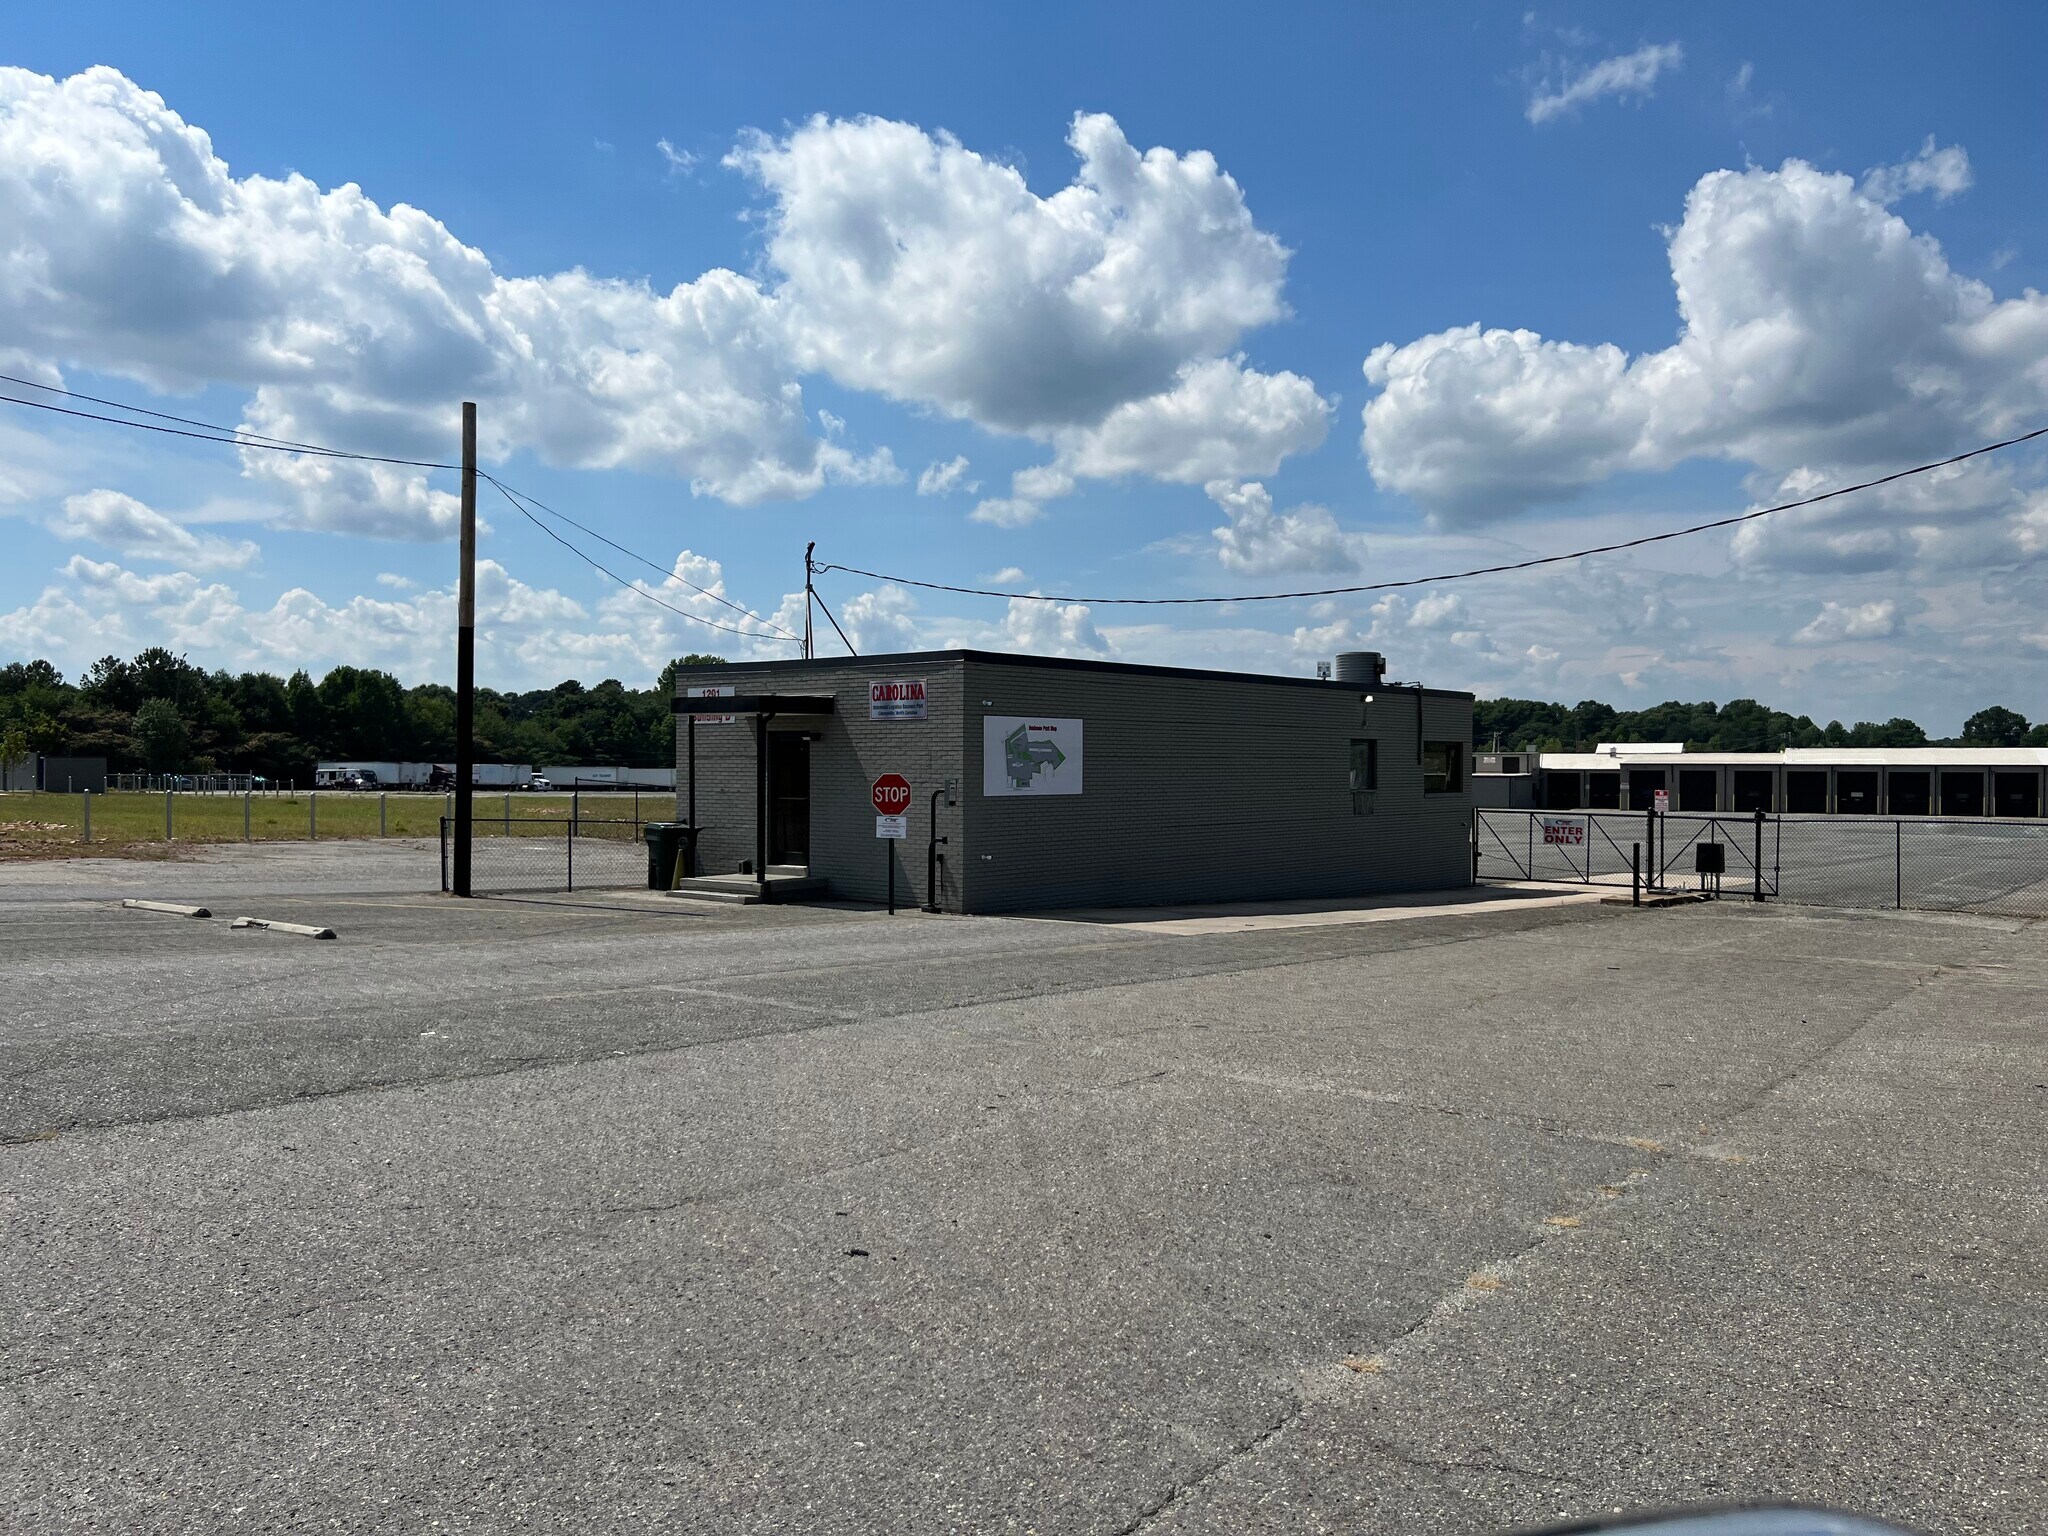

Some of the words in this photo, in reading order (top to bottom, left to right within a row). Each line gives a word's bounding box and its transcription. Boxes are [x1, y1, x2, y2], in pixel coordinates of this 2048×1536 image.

[702, 689, 720, 697] 1201
[872, 684, 925, 701] CAROLINA
[875, 787, 909, 803] STOP
[1545, 826, 1583, 835] ENTER
[1545, 835, 1583, 845] ONLY
